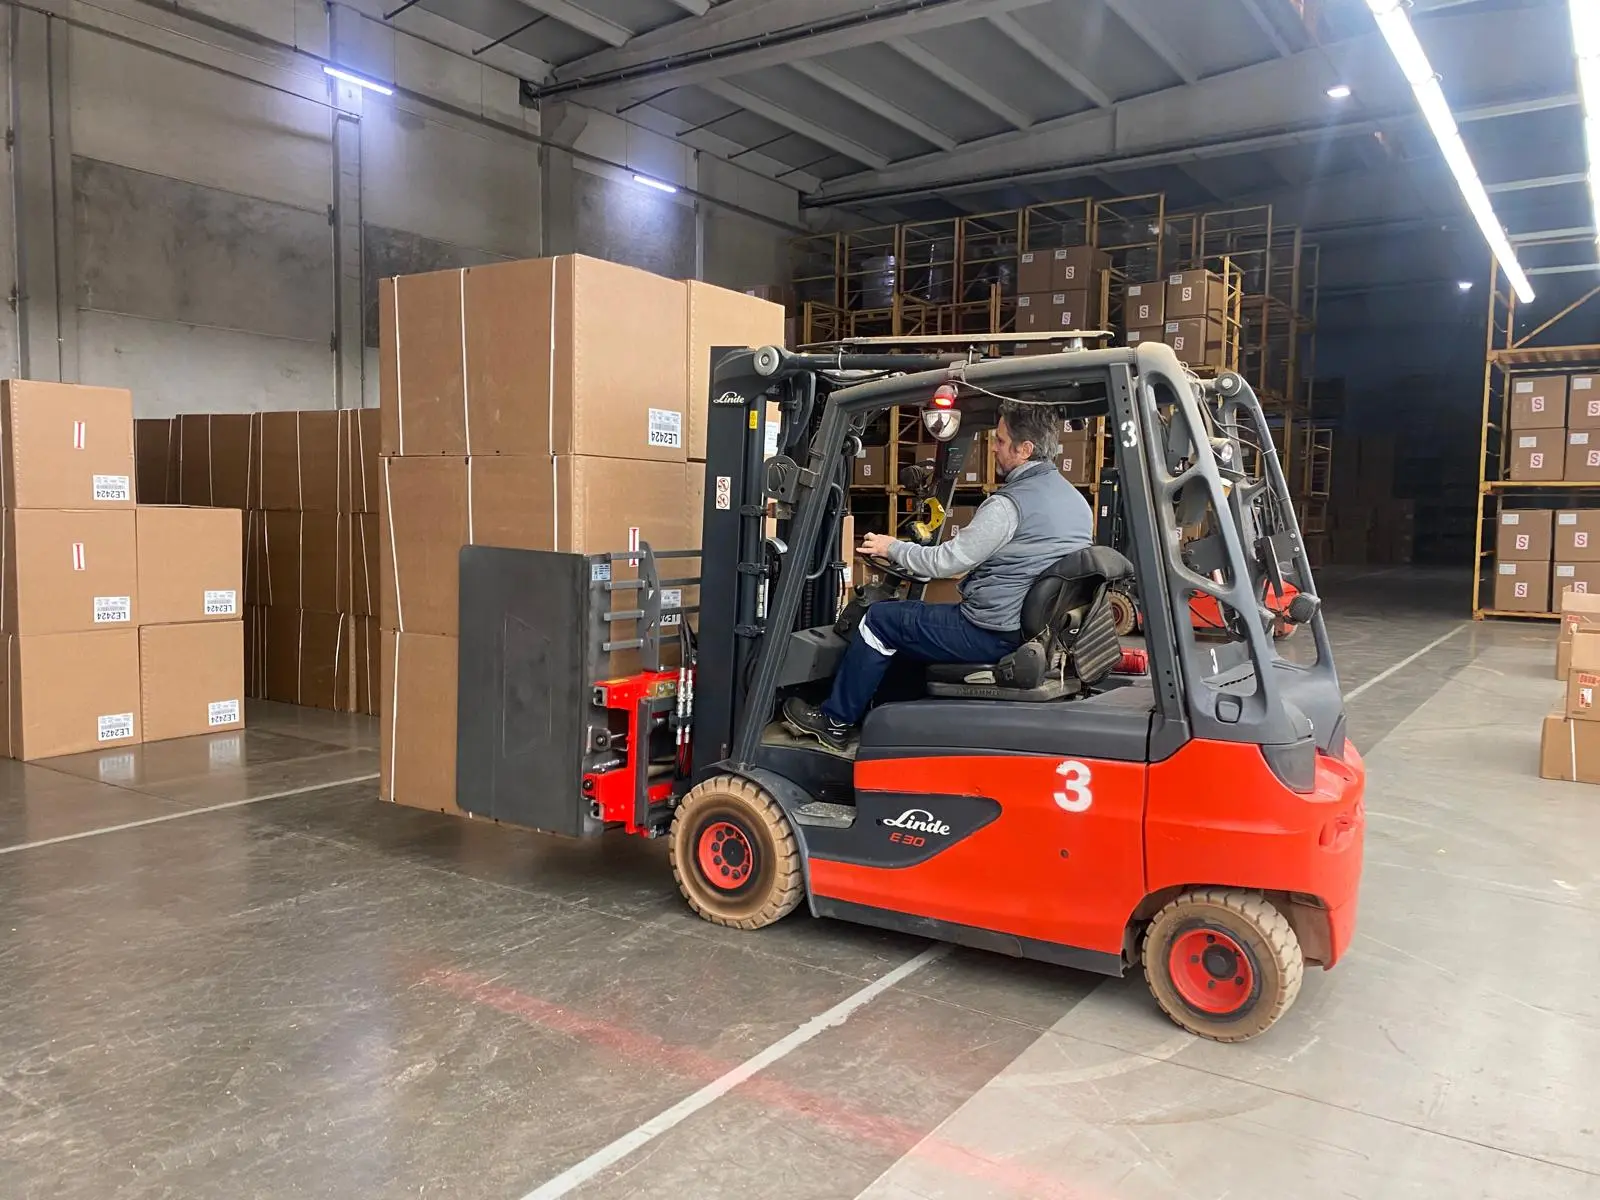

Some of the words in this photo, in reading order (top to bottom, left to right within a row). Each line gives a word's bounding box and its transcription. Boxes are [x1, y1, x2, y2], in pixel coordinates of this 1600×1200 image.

[713, 391, 745, 404] Linde
[651, 431, 678, 445] LE2424
[1121, 420, 1137, 448] 3
[97, 490, 126, 499] LE2424
[207, 604, 233, 613] LE2424
[97, 611, 126, 621] LE2424
[211, 713, 236, 724] LE2424
[101, 727, 130, 738] LE2424
[1053, 760, 1092, 812] 3
[883, 809, 950, 835] Linde
